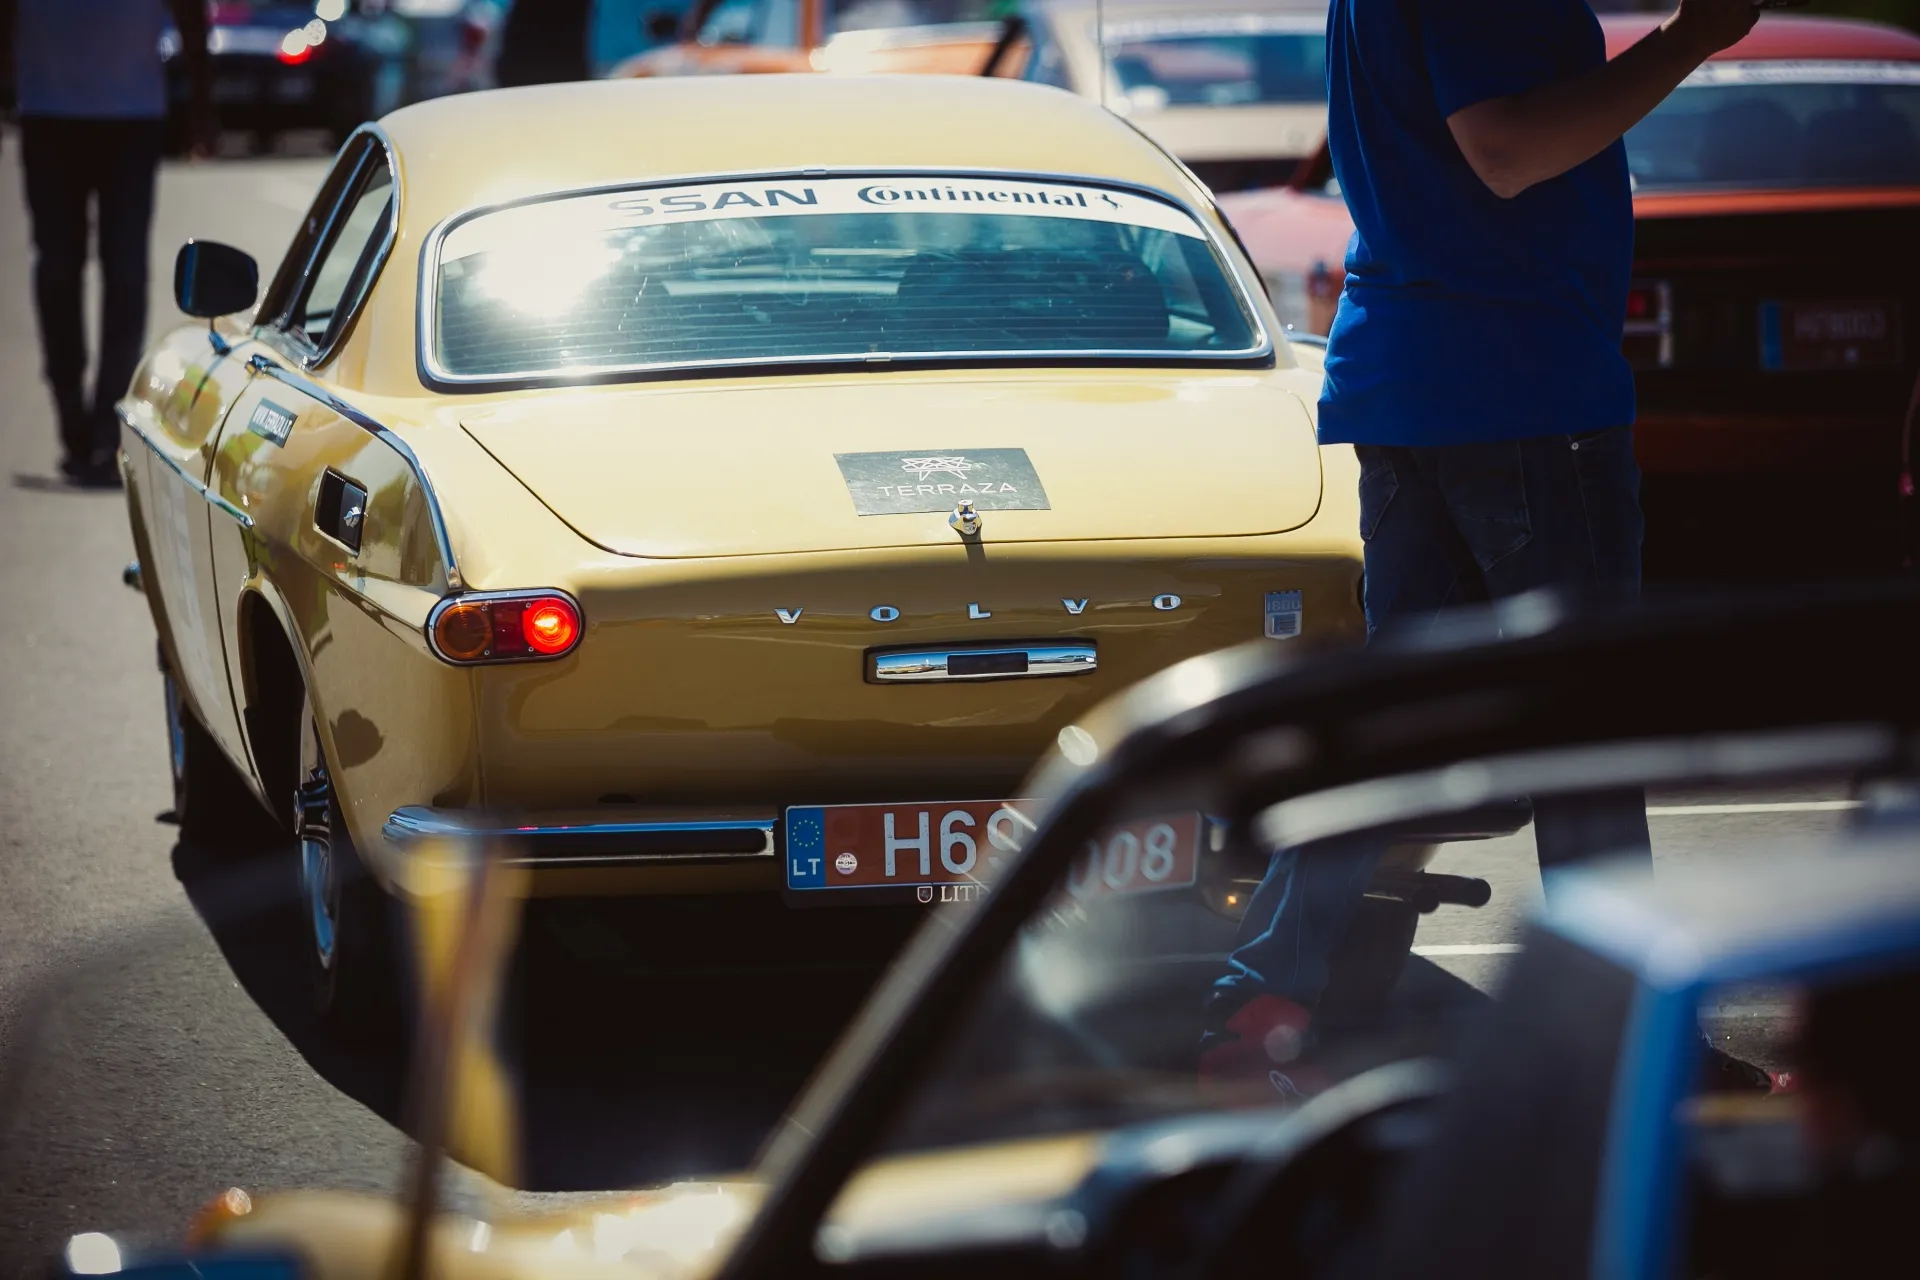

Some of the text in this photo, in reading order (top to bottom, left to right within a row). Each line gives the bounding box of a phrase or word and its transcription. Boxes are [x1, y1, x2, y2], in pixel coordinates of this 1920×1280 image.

[857, 185, 1088, 208] Continental
[877, 482, 1018, 497] TERRAZA
[774, 592, 1182, 624] VOLVO
[793, 858, 821, 876] LT
